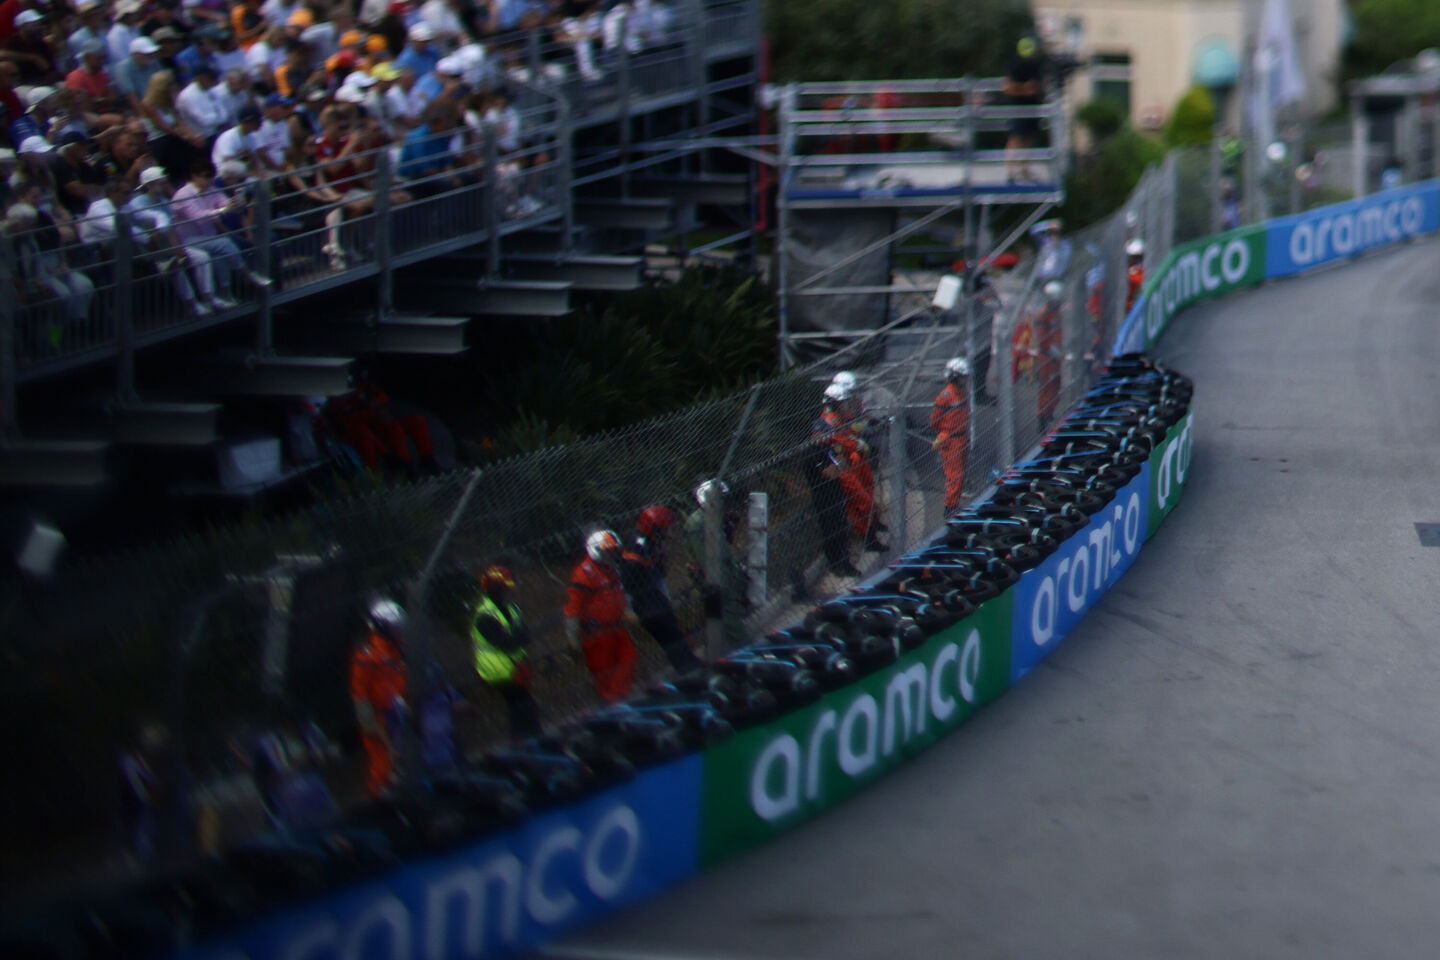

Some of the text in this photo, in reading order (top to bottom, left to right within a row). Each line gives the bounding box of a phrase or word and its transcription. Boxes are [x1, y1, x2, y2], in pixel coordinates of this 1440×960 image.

[1147, 239, 1249, 340] aramco
[1289, 196, 1426, 265] aramco
[1031, 492, 1140, 646] aramco
[750, 627, 980, 821] aramco
[213, 803, 640, 960] amco
